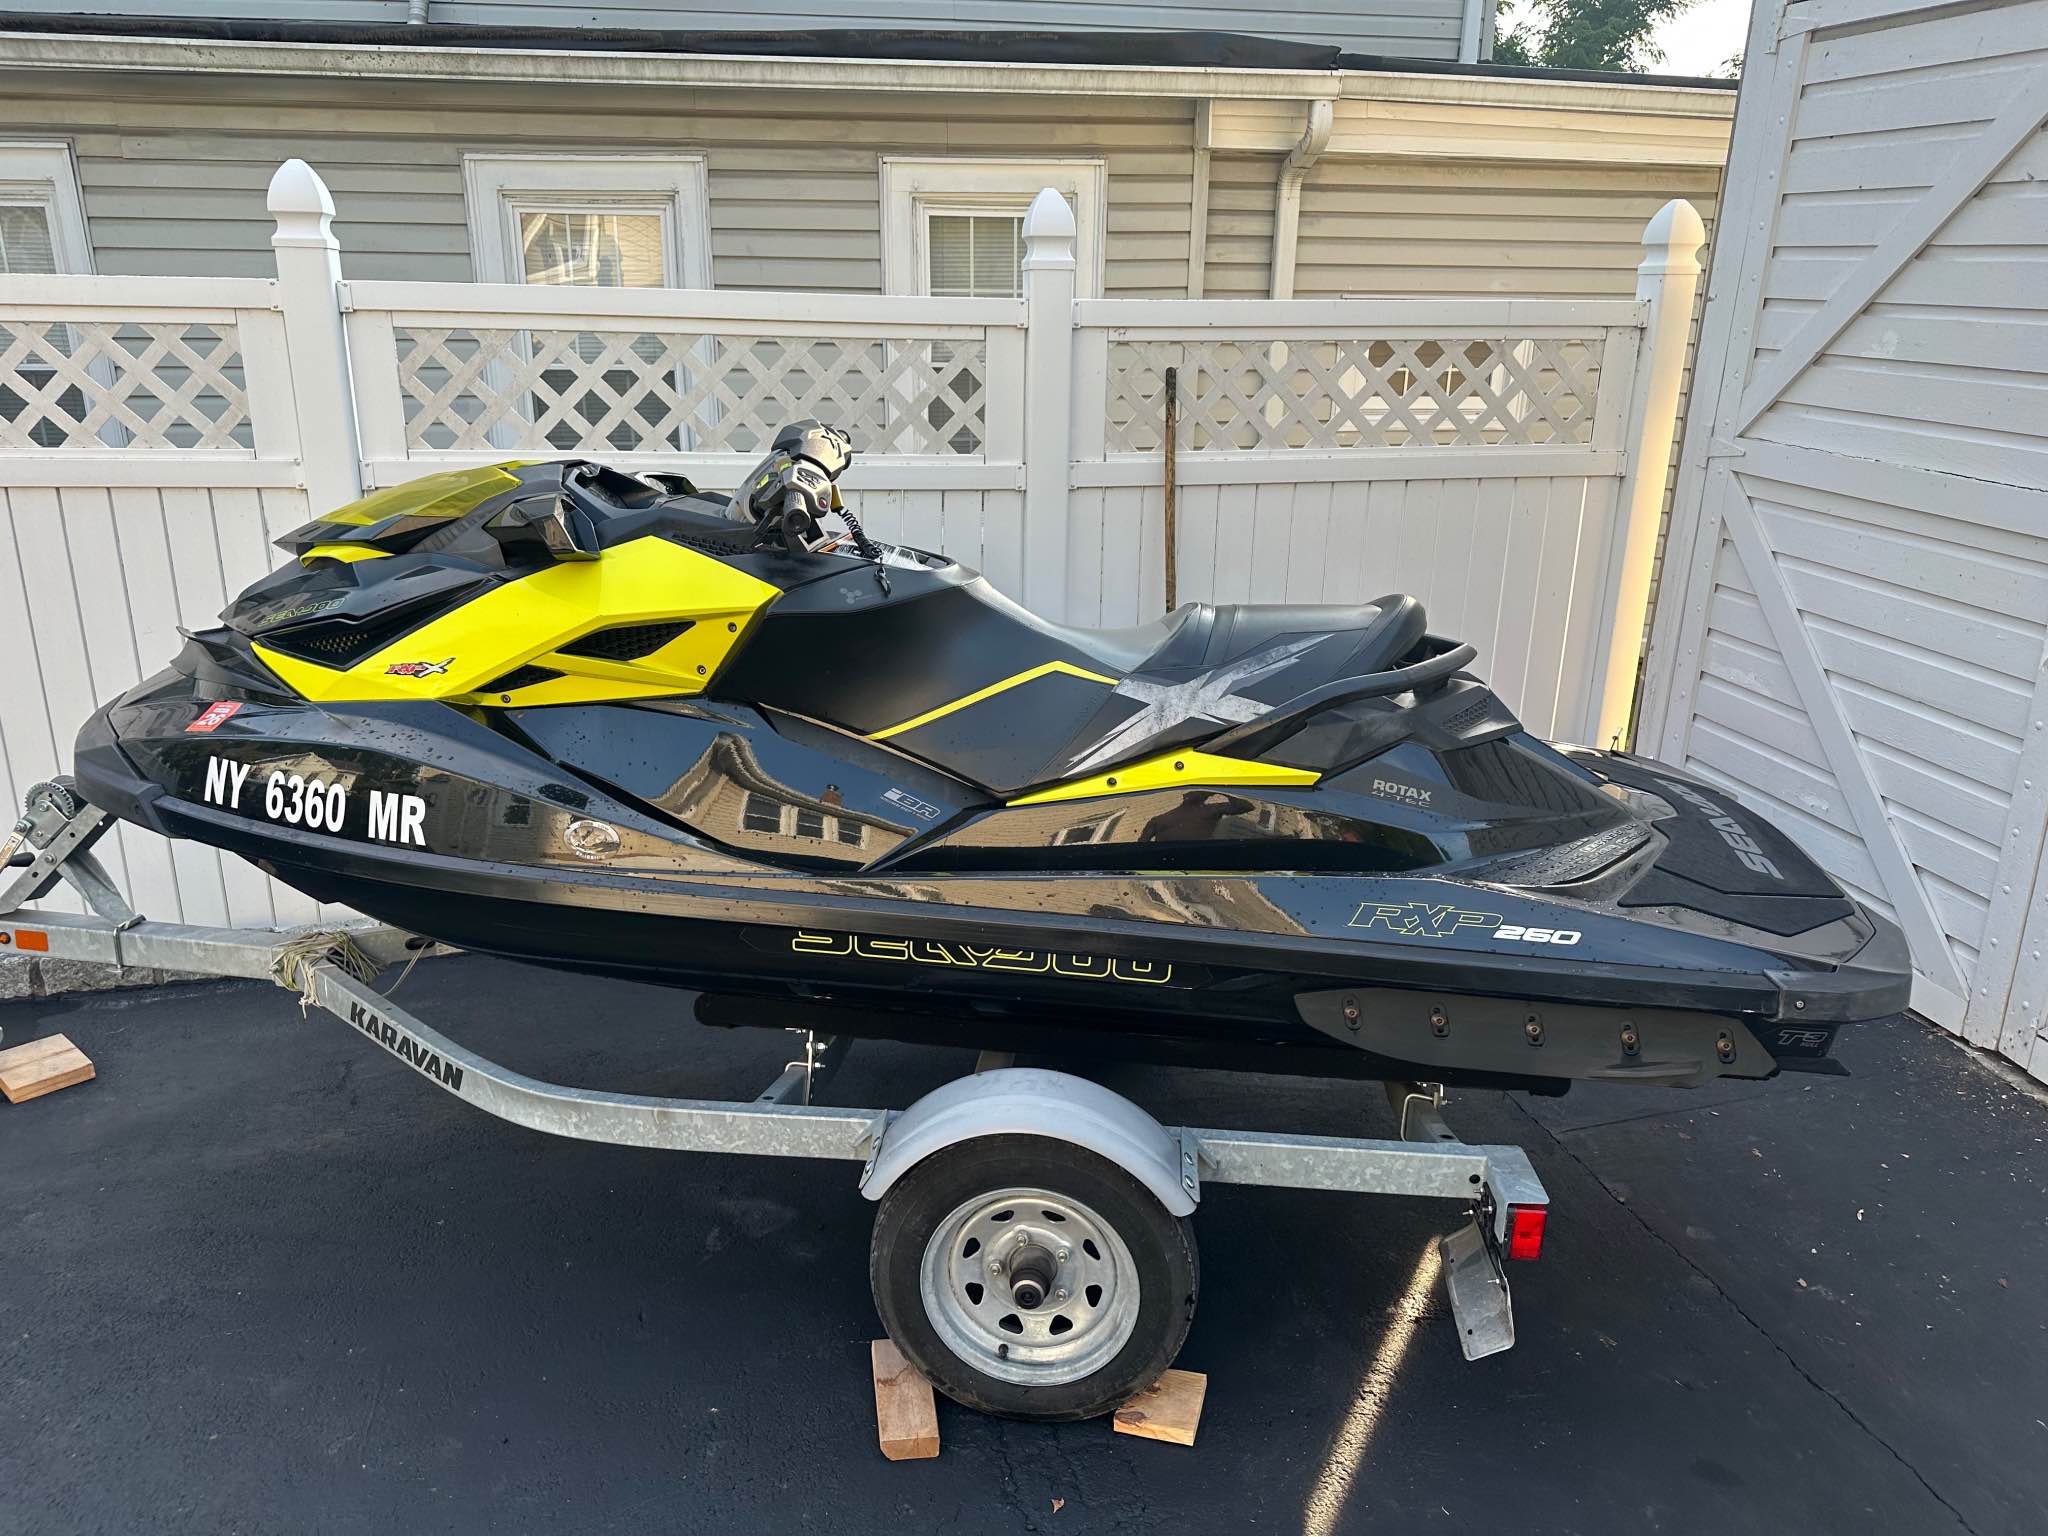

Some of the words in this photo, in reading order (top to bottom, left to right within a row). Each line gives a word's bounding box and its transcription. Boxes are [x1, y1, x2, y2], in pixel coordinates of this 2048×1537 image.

[204, 756, 251, 809] NY
[265, 770, 346, 832] 6360
[368, 790, 426, 846] MR
[1373, 779, 1432, 801] ROTAX
[1347, 902, 1504, 937] RXP
[1493, 924, 1582, 945] 260
[350, 1000, 464, 1092] KARAVAN
